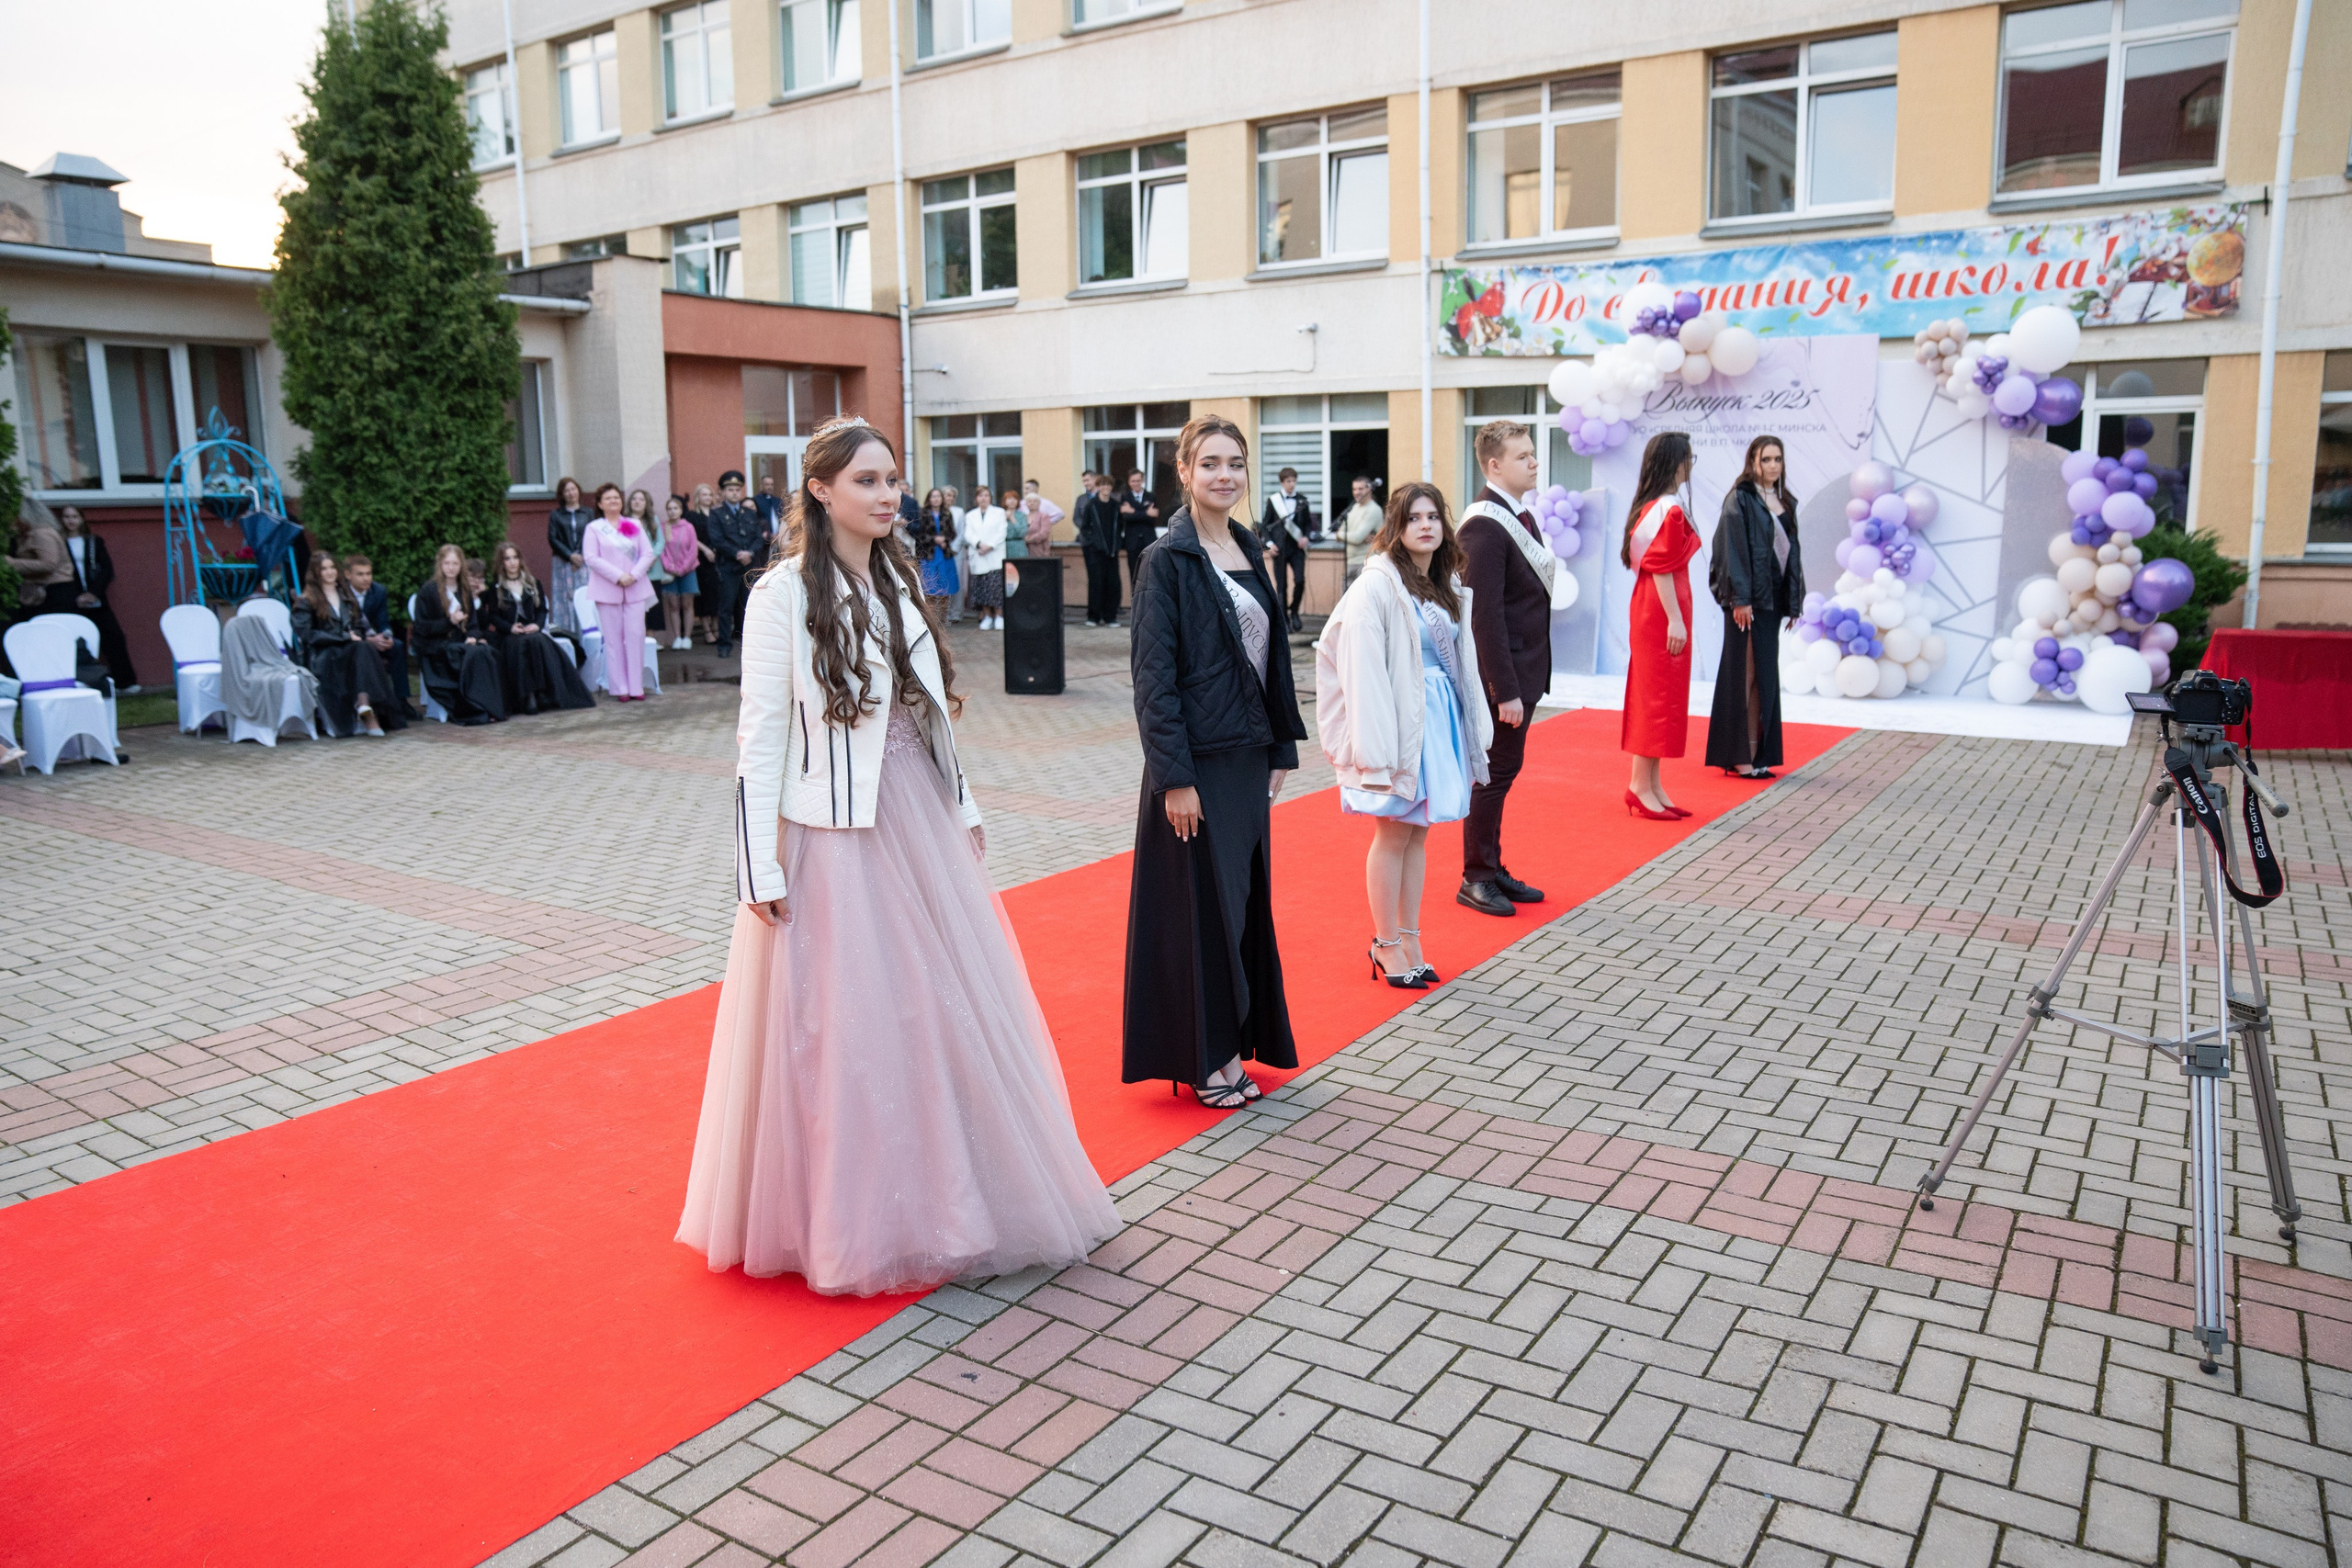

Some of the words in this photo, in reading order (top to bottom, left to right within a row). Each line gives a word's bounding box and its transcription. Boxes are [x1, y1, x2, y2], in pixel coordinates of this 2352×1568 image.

[1521, 279, 1589, 323] До
[1891, 235, 2119, 300] школа!
[1643, 379, 1752, 423] Выпуск
[1752, 389, 1820, 410] 2025
[1705, 424, 1745, 434] ШКОЛА
[1778, 423, 1827, 433] МИНСКА
[2182, 776, 2208, 814] Canon
[2248, 792, 2260, 833] DIGITAL
[2254, 836, 2267, 858] EOS
